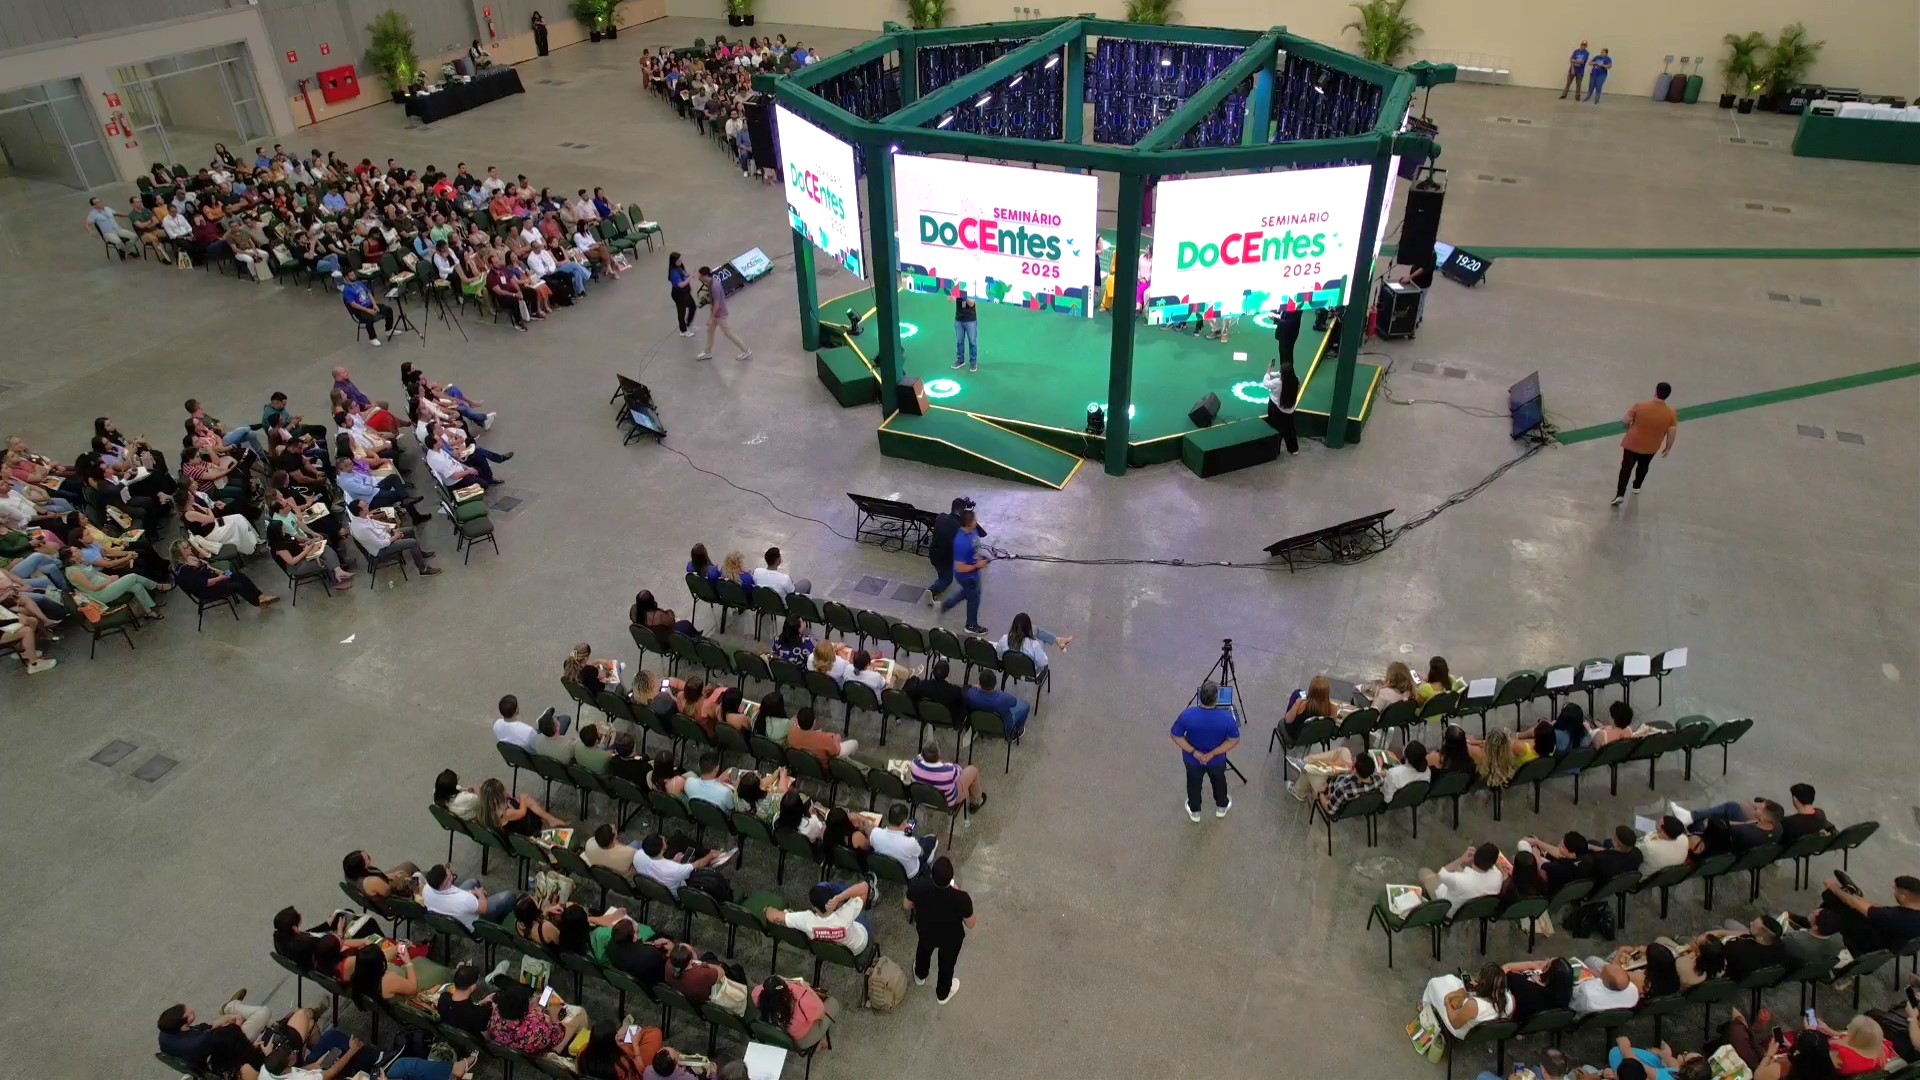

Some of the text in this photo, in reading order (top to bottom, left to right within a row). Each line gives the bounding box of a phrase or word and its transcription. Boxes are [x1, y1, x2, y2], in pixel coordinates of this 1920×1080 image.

[993, 207, 1062, 227] SEMINÁRIO
[919, 214, 1062, 261] DoCEntes
[1177, 229, 1326, 270] DoCEntes
[1021, 261, 1061, 279] 2025
[1283, 262, 1321, 278] 2025
[1455, 254, 1482, 272] 19:20
[712, 268, 732, 283] 9:20
